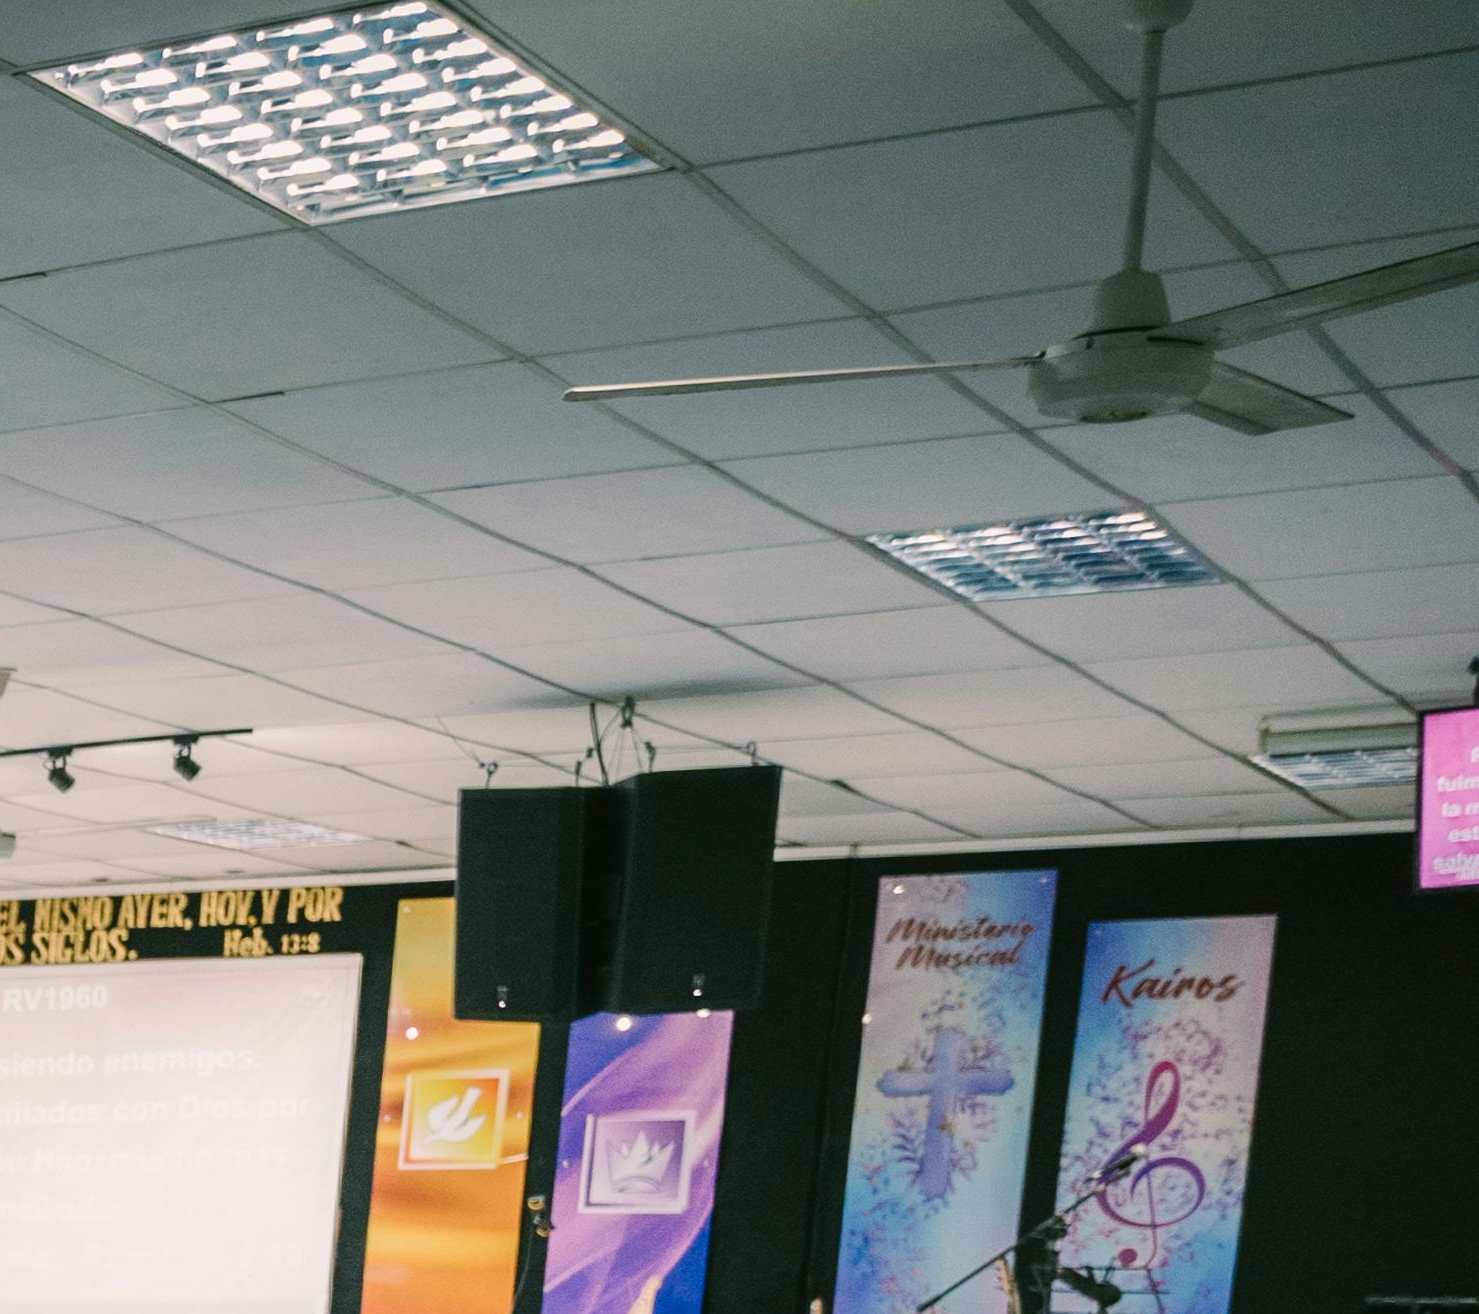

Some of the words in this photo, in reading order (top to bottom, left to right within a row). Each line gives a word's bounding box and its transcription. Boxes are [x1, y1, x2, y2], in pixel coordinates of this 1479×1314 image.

[117, 892, 193, 931] AYER,
[286, 886, 344, 924] POR
[30, 928, 139, 965] SIGLOS.
[896, 941, 1022, 970] Musical
[2, 984, 109, 1013] RV1960
[1101, 957, 1246, 1008] Kairos
